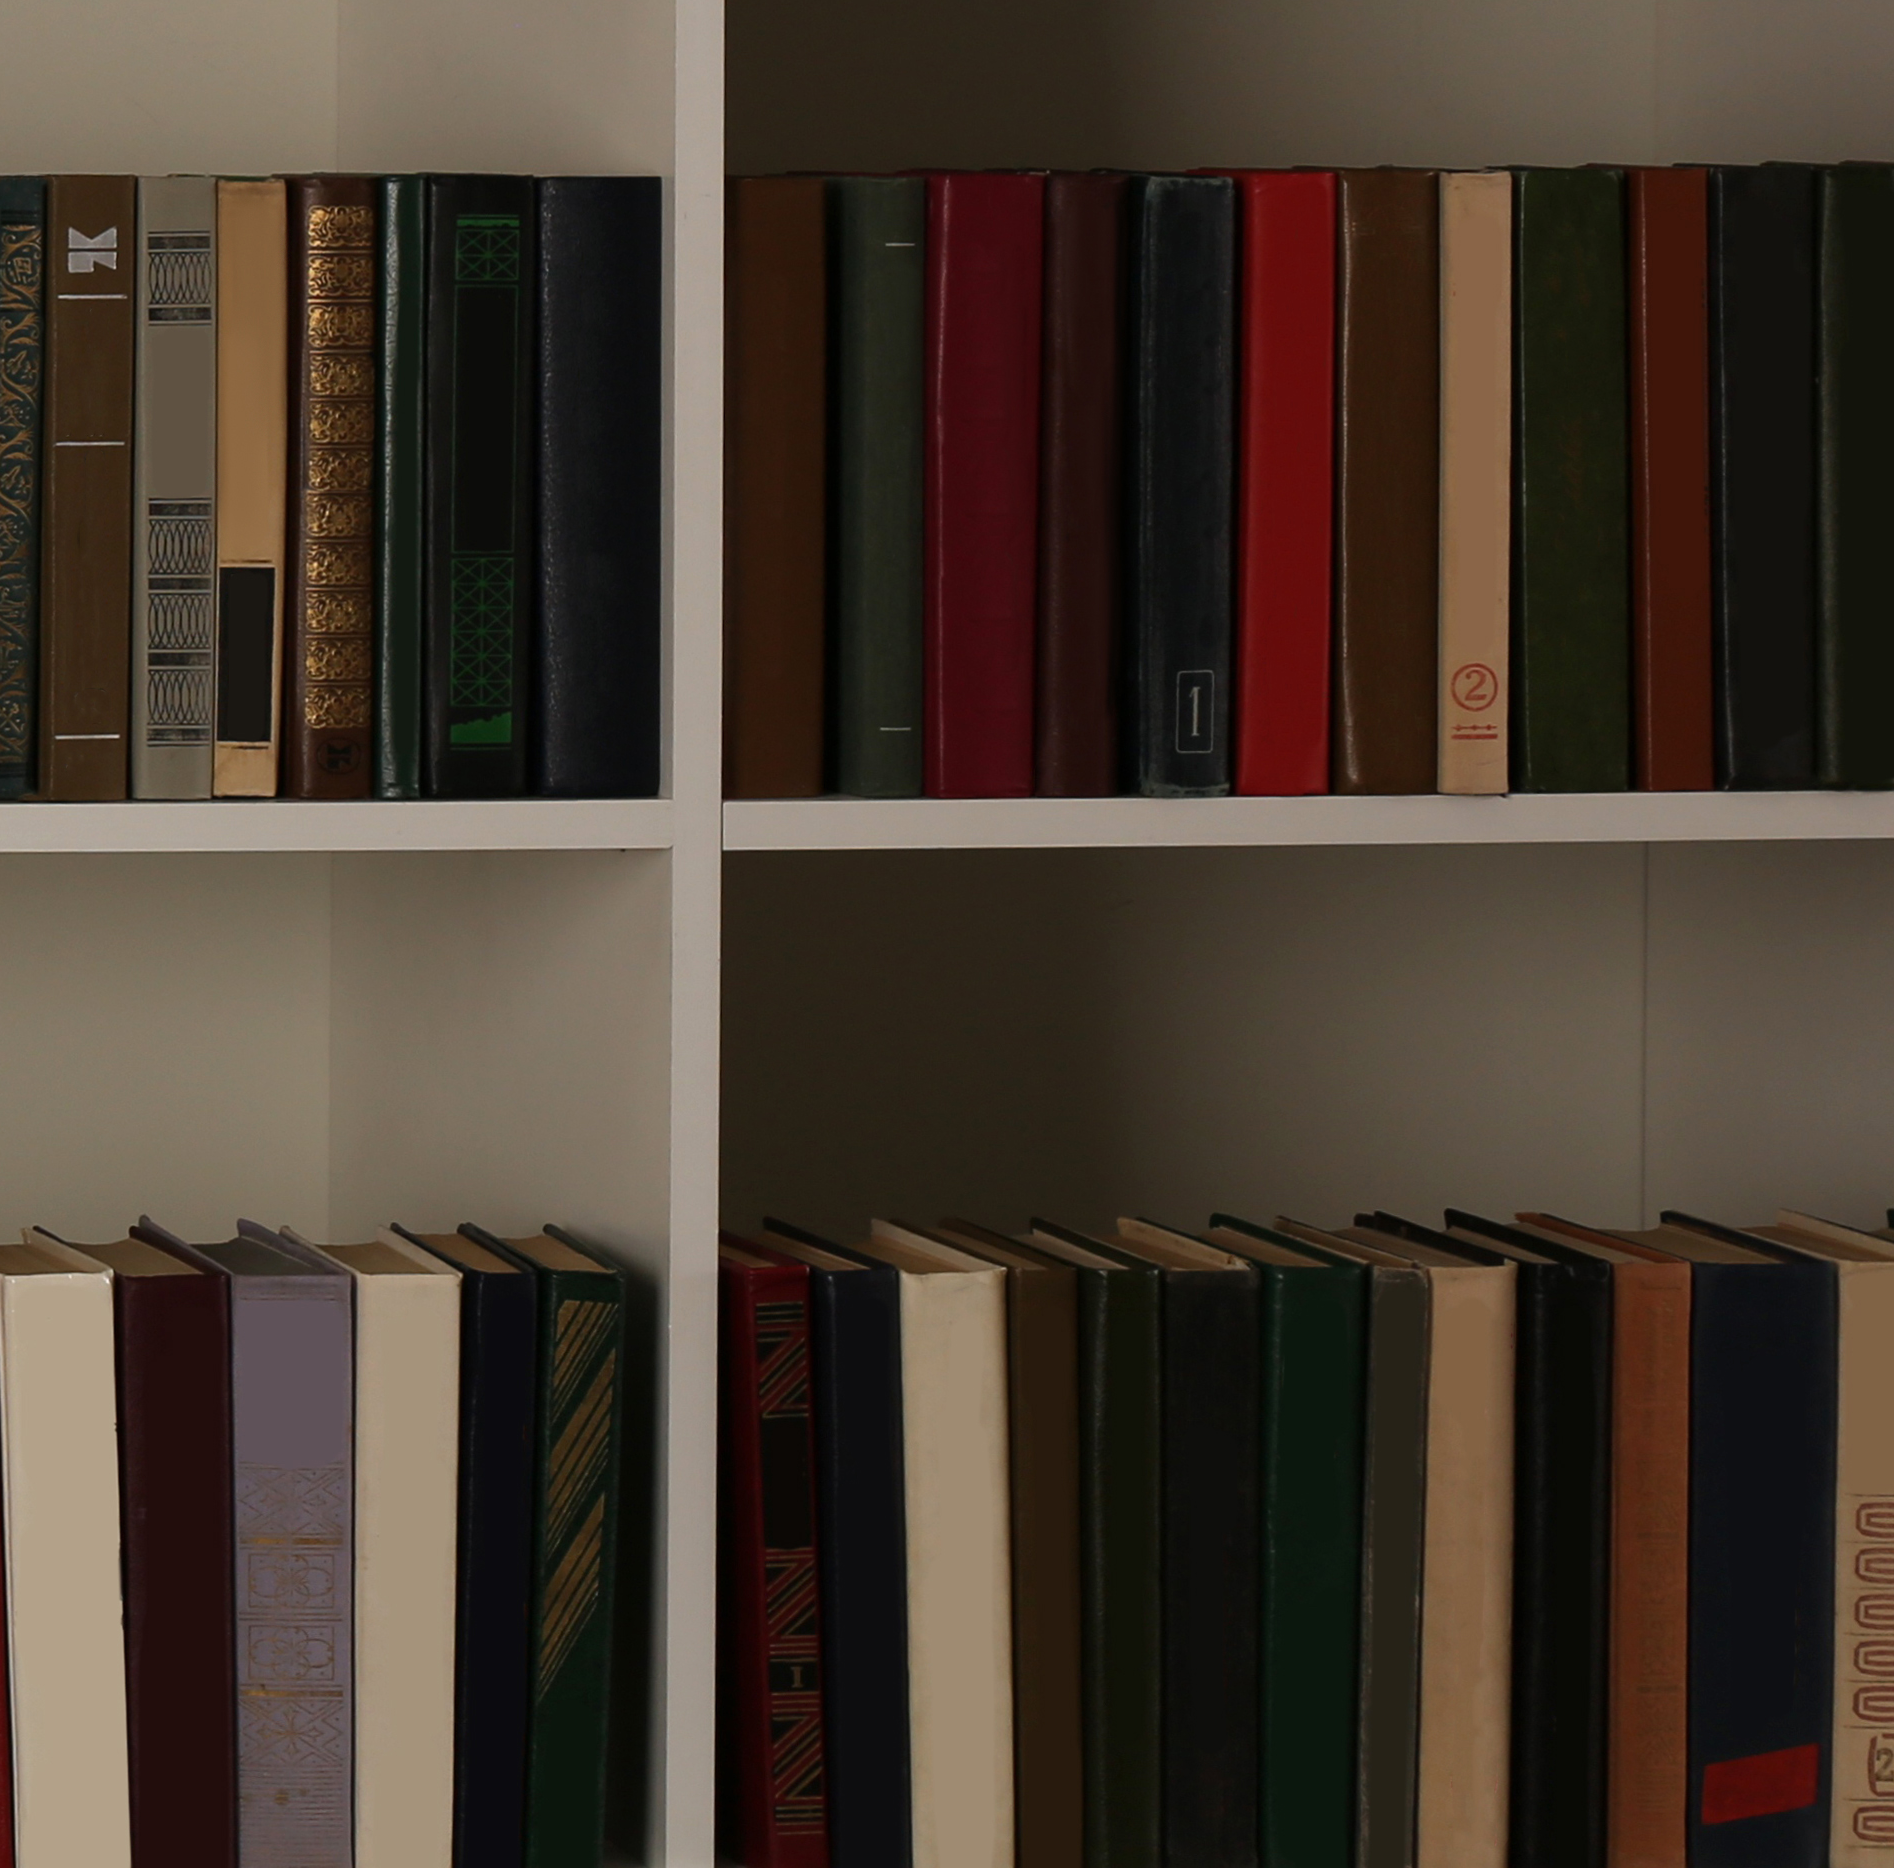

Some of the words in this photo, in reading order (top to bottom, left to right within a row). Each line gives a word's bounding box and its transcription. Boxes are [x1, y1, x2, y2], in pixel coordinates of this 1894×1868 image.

[1465, 669, 1488, 701] 2
[1188, 686, 1200, 737] 1
[790, 1666, 803, 1688] I
[1876, 1748, 1894, 1782] 2
